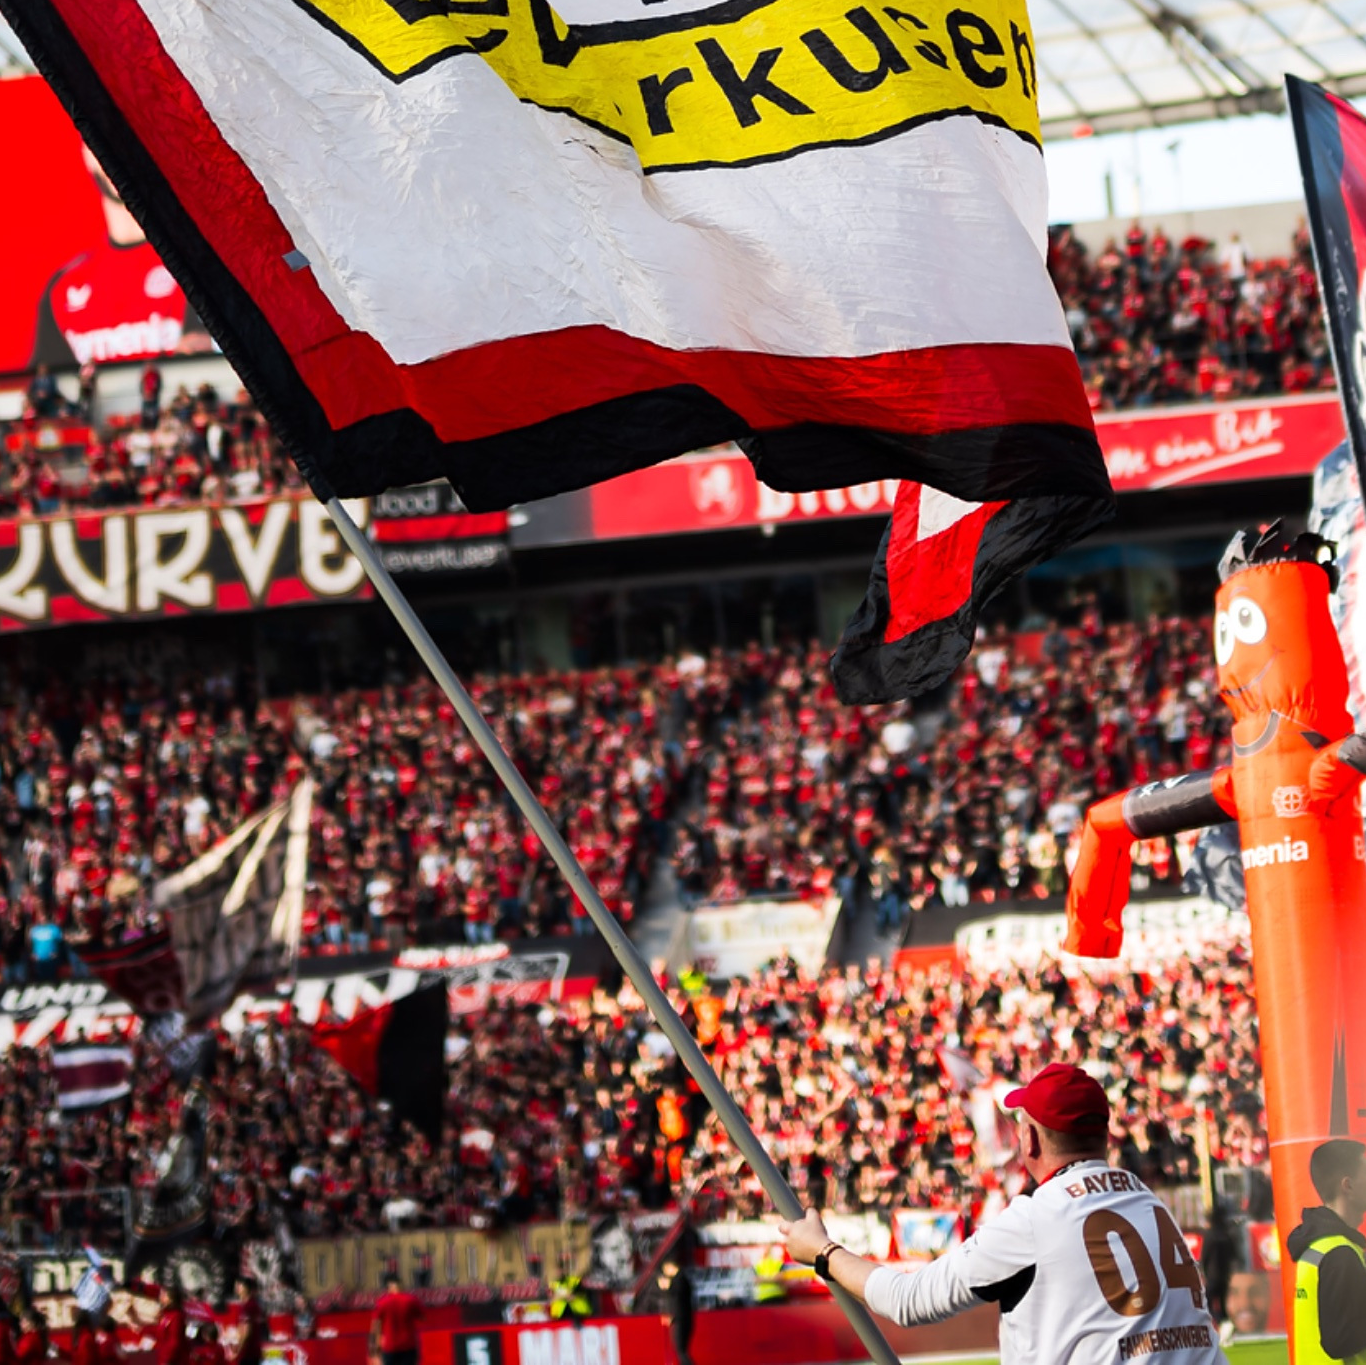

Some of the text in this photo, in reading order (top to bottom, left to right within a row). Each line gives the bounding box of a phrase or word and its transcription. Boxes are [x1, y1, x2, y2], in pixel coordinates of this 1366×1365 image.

[1214, 409, 1283, 452] Bit
[1065, 1171, 1131, 1199] BAYER
[1082, 1205, 1206, 1318] 04
